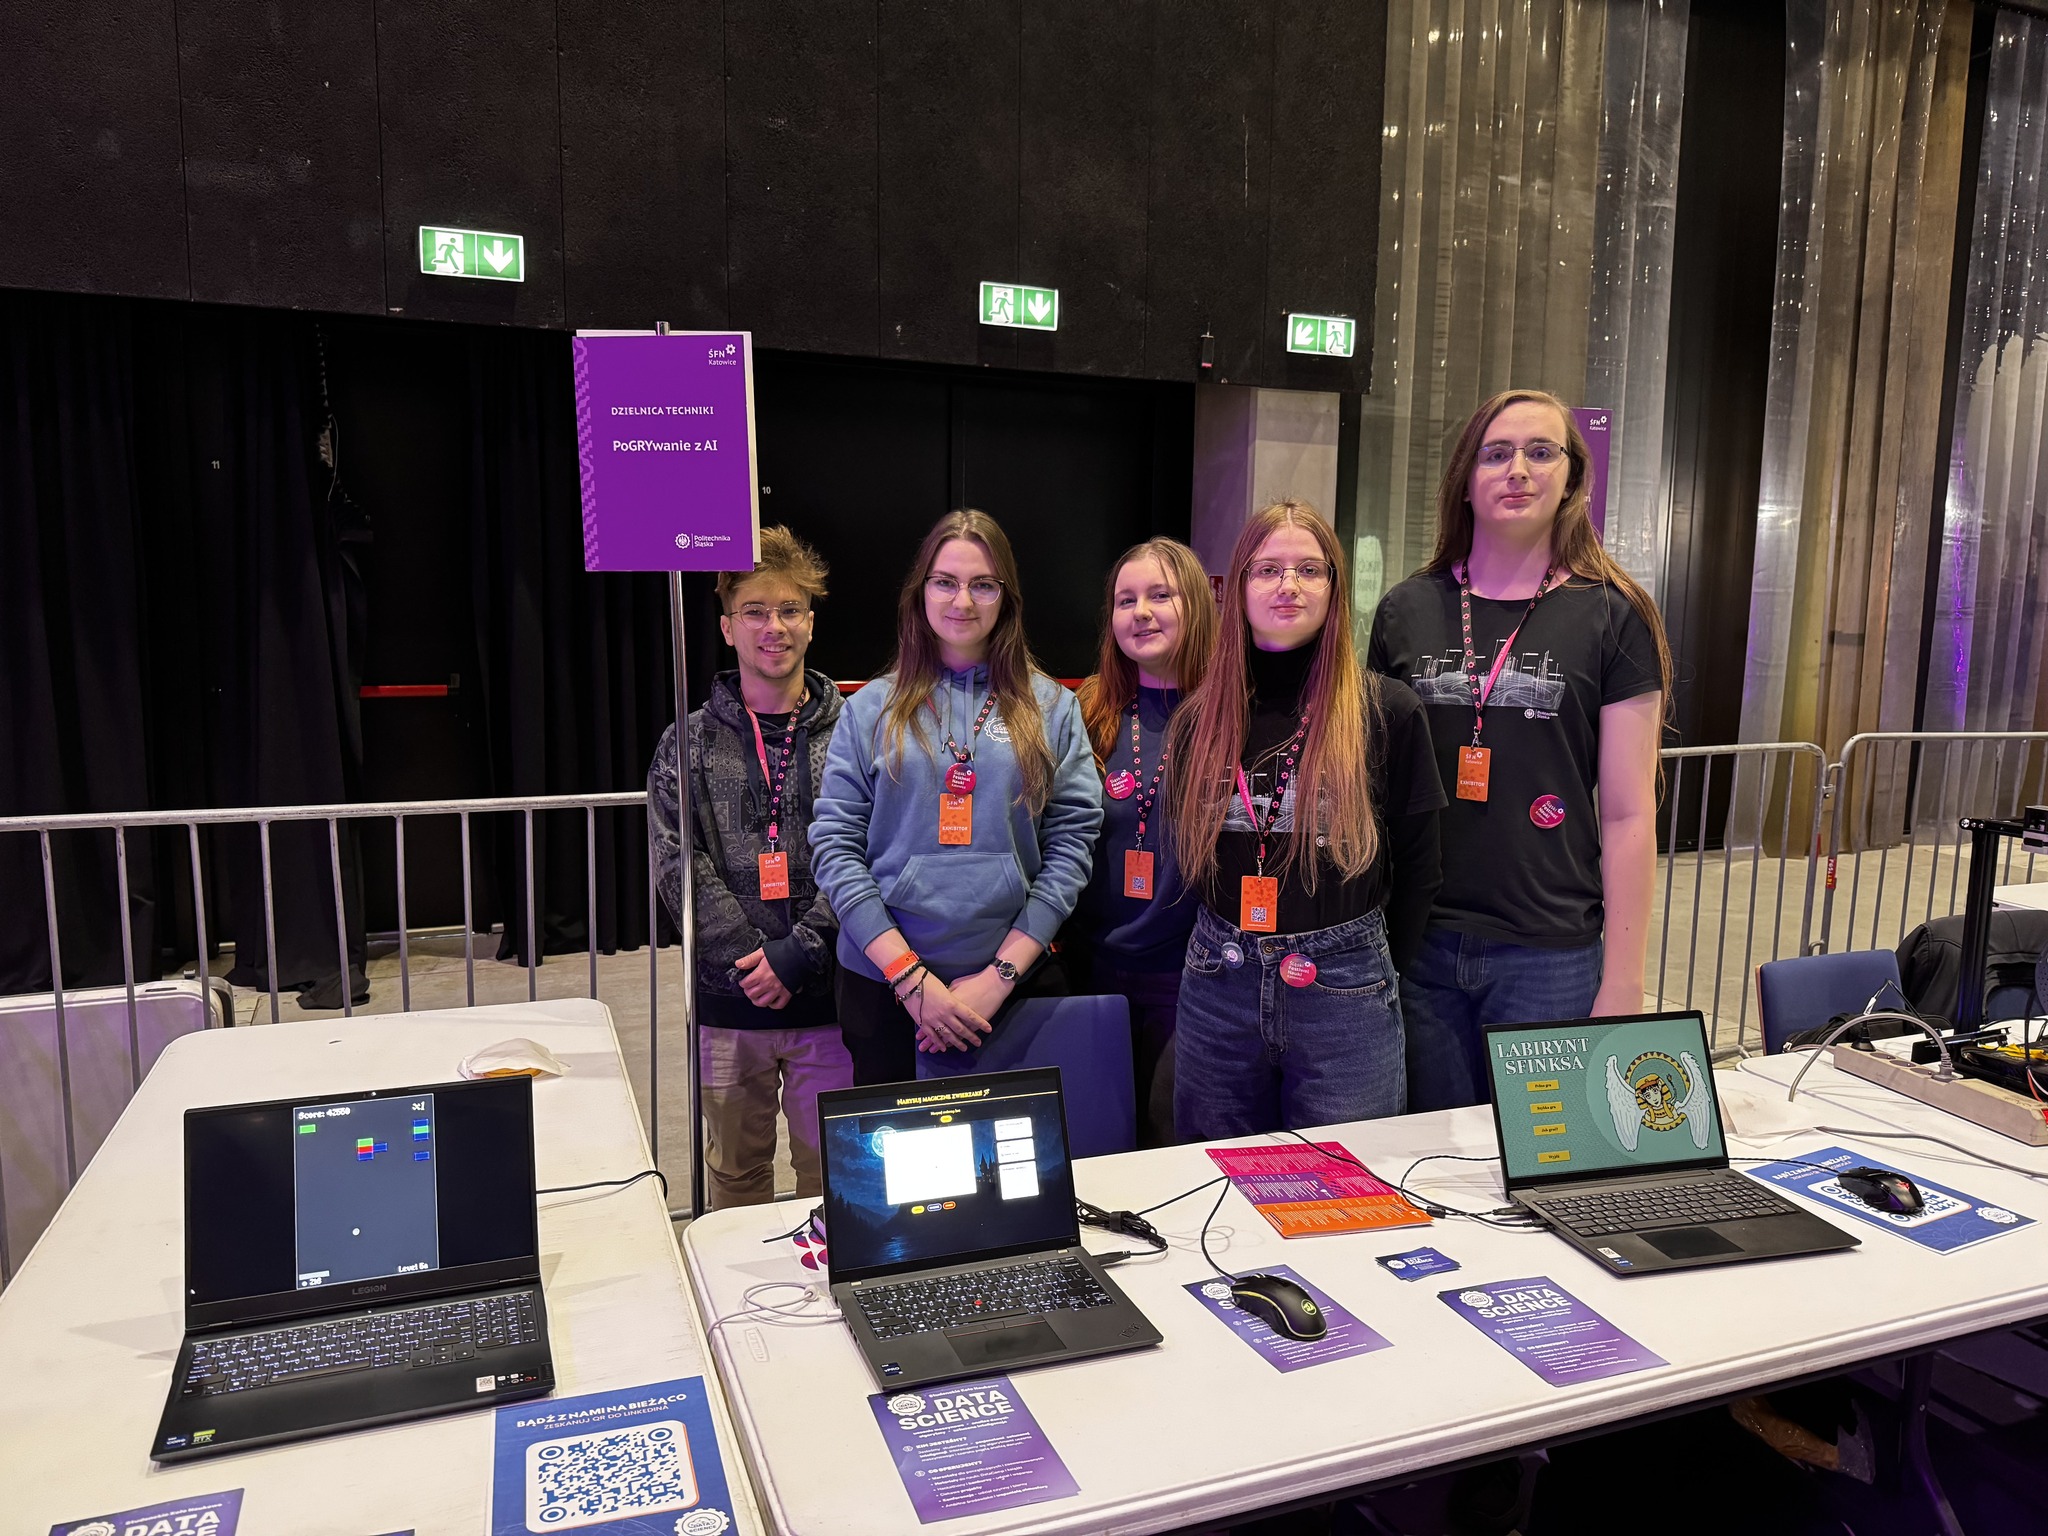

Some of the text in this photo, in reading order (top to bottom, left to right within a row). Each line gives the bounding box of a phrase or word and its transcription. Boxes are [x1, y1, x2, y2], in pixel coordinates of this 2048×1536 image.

[708, 348, 725, 358] ŚFN
[611, 406, 714, 416] DZIELNICA TECHNIKI
[613, 440, 718, 452] PoGRYwanie z AI
[211, 460, 220, 470] 11
[762, 486, 771, 494] 10
[1497, 1038, 1589, 1058] LABIRYNT
[1505, 1055, 1585, 1075] SFINKSA
[398, 1263, 418, 1272] Level
[352, 1284, 387, 1295] LEGION
[1498, 1288, 1560, 1304] DATA
[1478, 1297, 1572, 1318] SCIENCE
[934, 1390, 1008, 1412] DATA
[516, 1393, 687, 1428] BĄDŹ Z NAMI NA BIEŻĄCO
[544, 1418, 590, 1430] ZESKANUJ
[623, 1405, 669, 1416] LINKEDINA
[898, 1400, 1015, 1430] SCIENCE
[124, 1510, 220, 1536] DATA
